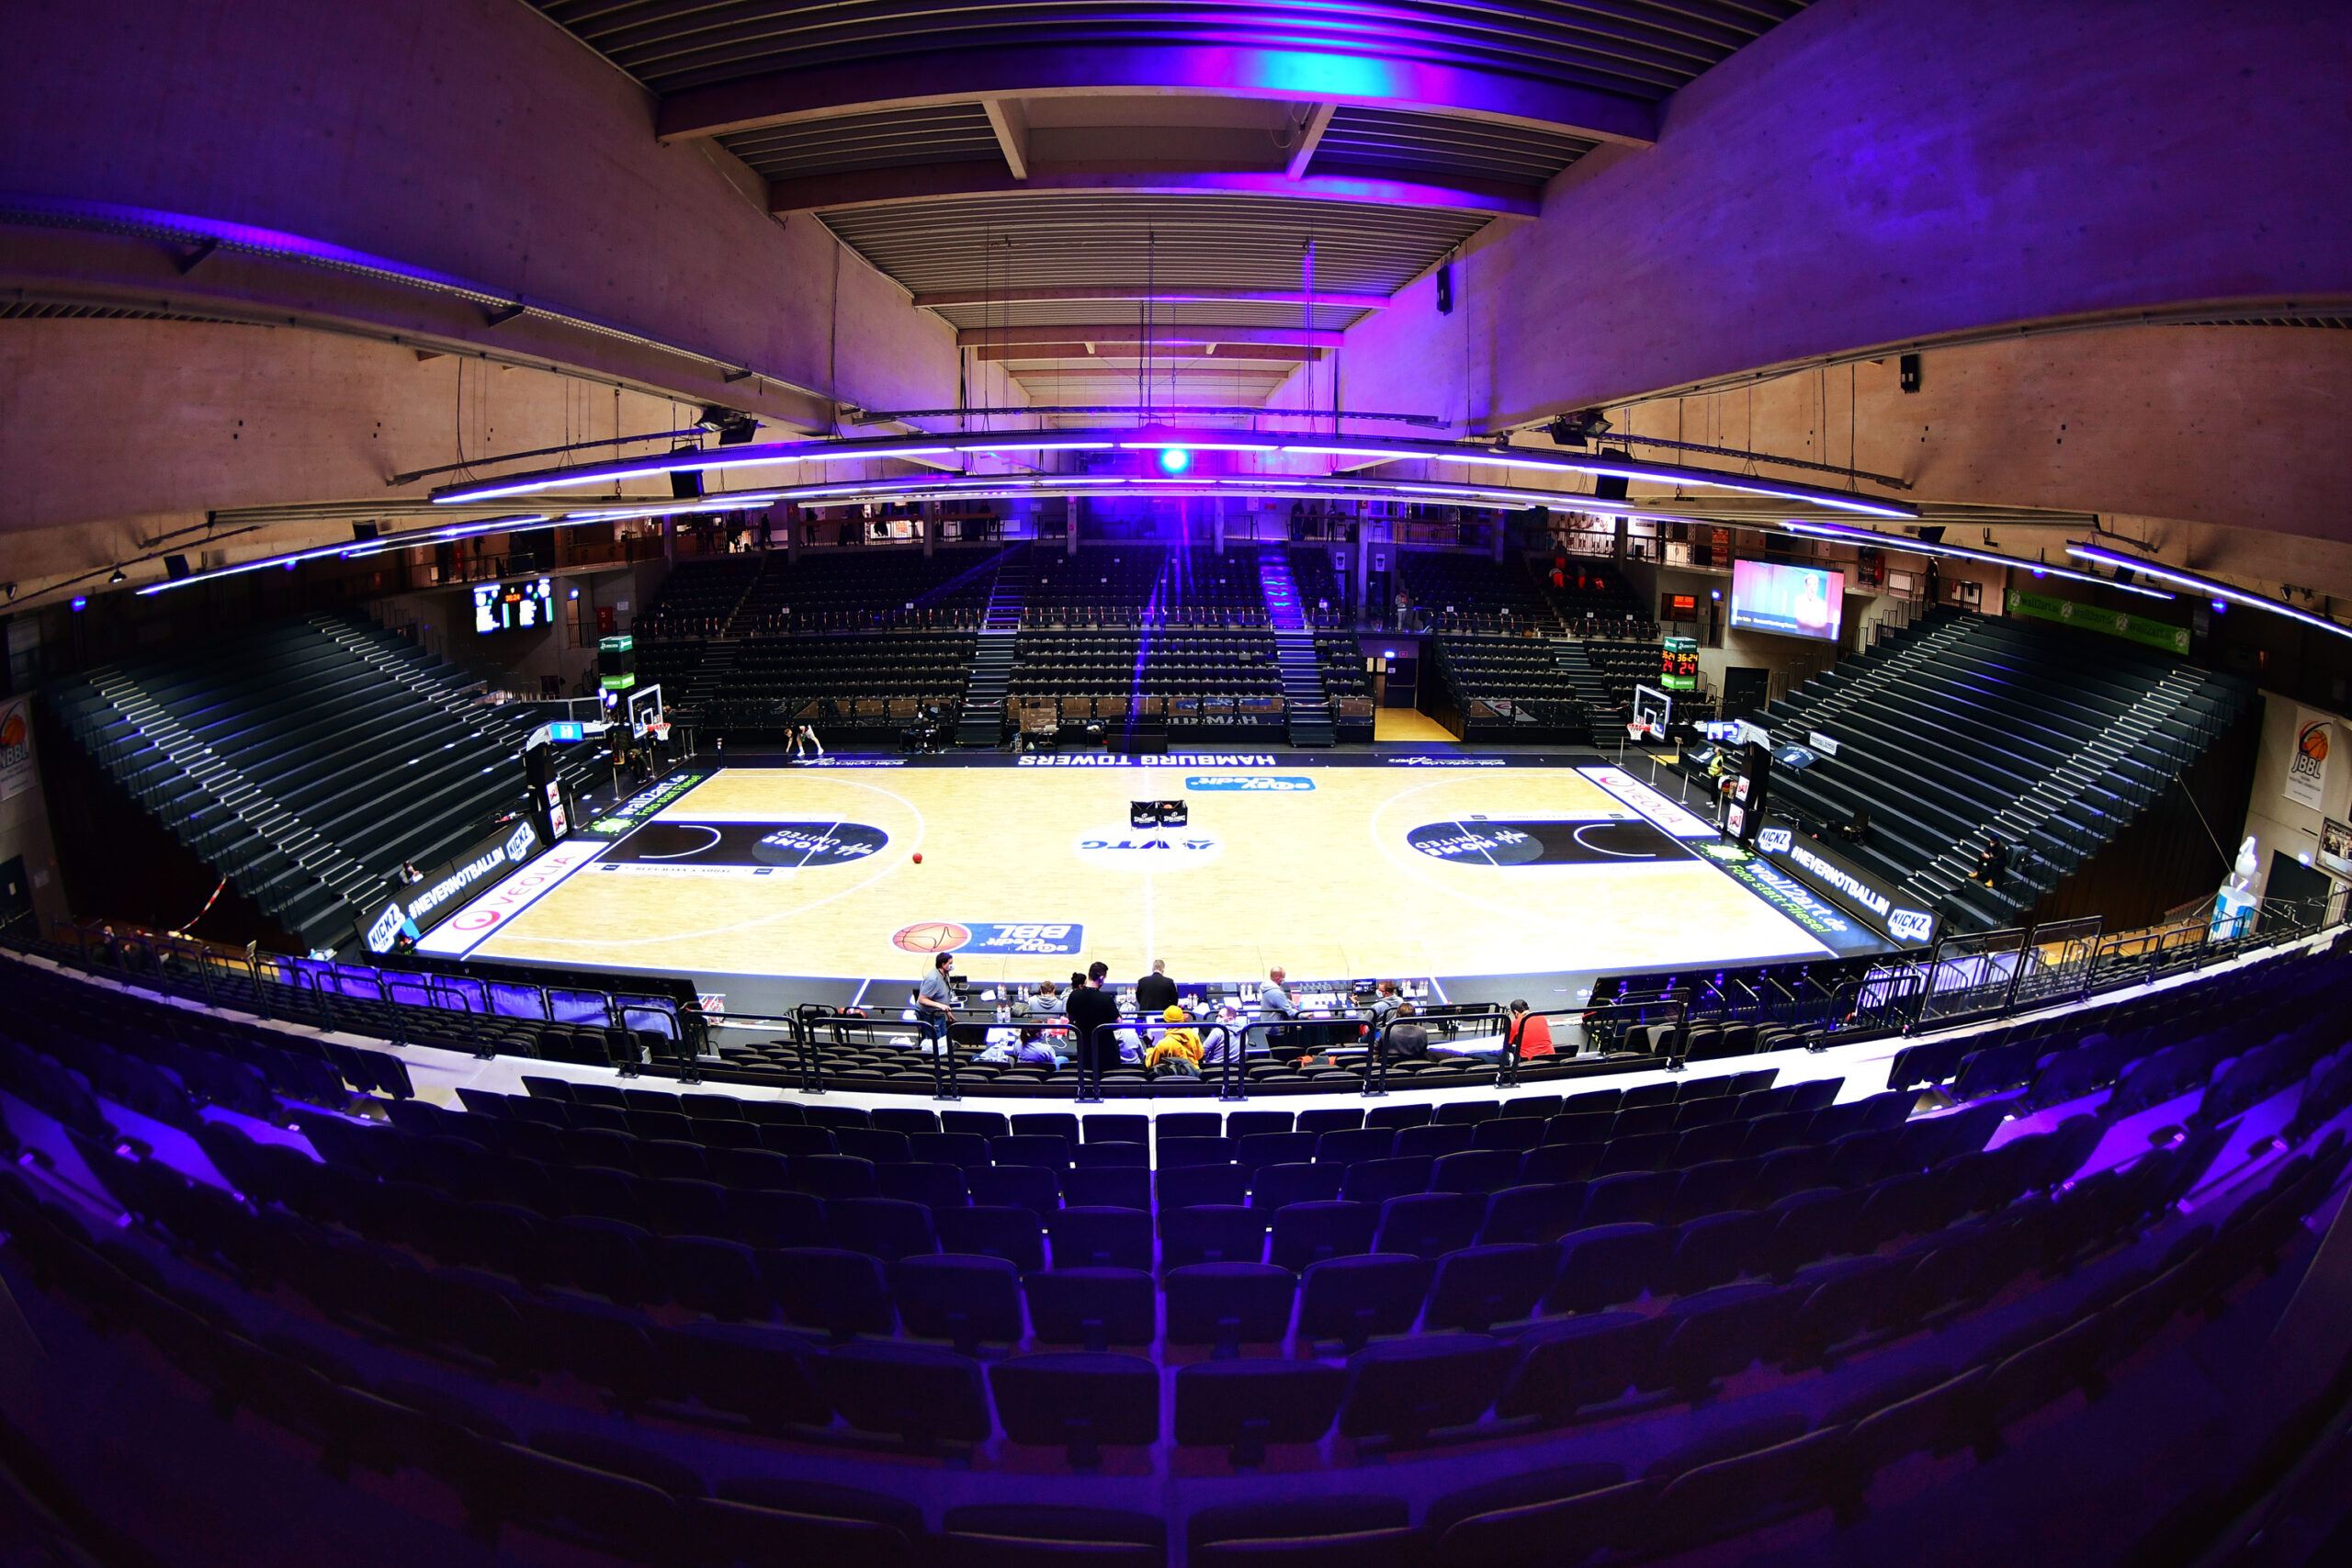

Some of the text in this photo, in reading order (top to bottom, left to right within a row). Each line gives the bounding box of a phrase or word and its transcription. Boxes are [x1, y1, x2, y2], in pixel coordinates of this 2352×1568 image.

[1663, 659, 1673, 672] 24
[1679, 662, 1695, 675] 24
[1018, 755, 1277, 766] HAMBURG TOWERS
[2291, 751, 2321, 780] JBBL
[616, 774, 689, 816] wall2art.de
[634, 803, 662, 816] Foto
[656, 790, 681, 804] statt
[1624, 788, 1682, 824] VEOLIA
[508, 826, 529, 855] KICKZ
[777, 830, 841, 845] UNITED
[1415, 834, 1485, 849] UNITED
[1761, 829, 1786, 846] KICKZ
[408, 846, 506, 919] #NEVERNOTBALLIN
[490, 856, 577, 906] VEOLIA
[1791, 845, 1891, 917] #NEVERNOTBALLIN
[1726, 864, 1833, 933] Foto statt Fliese!
[1746, 863, 1848, 931] wall2art.de
[370, 907, 400, 947] KICKZ
[992, 924, 1072, 939] BBL
[1892, 912, 1928, 932] KICKZ
